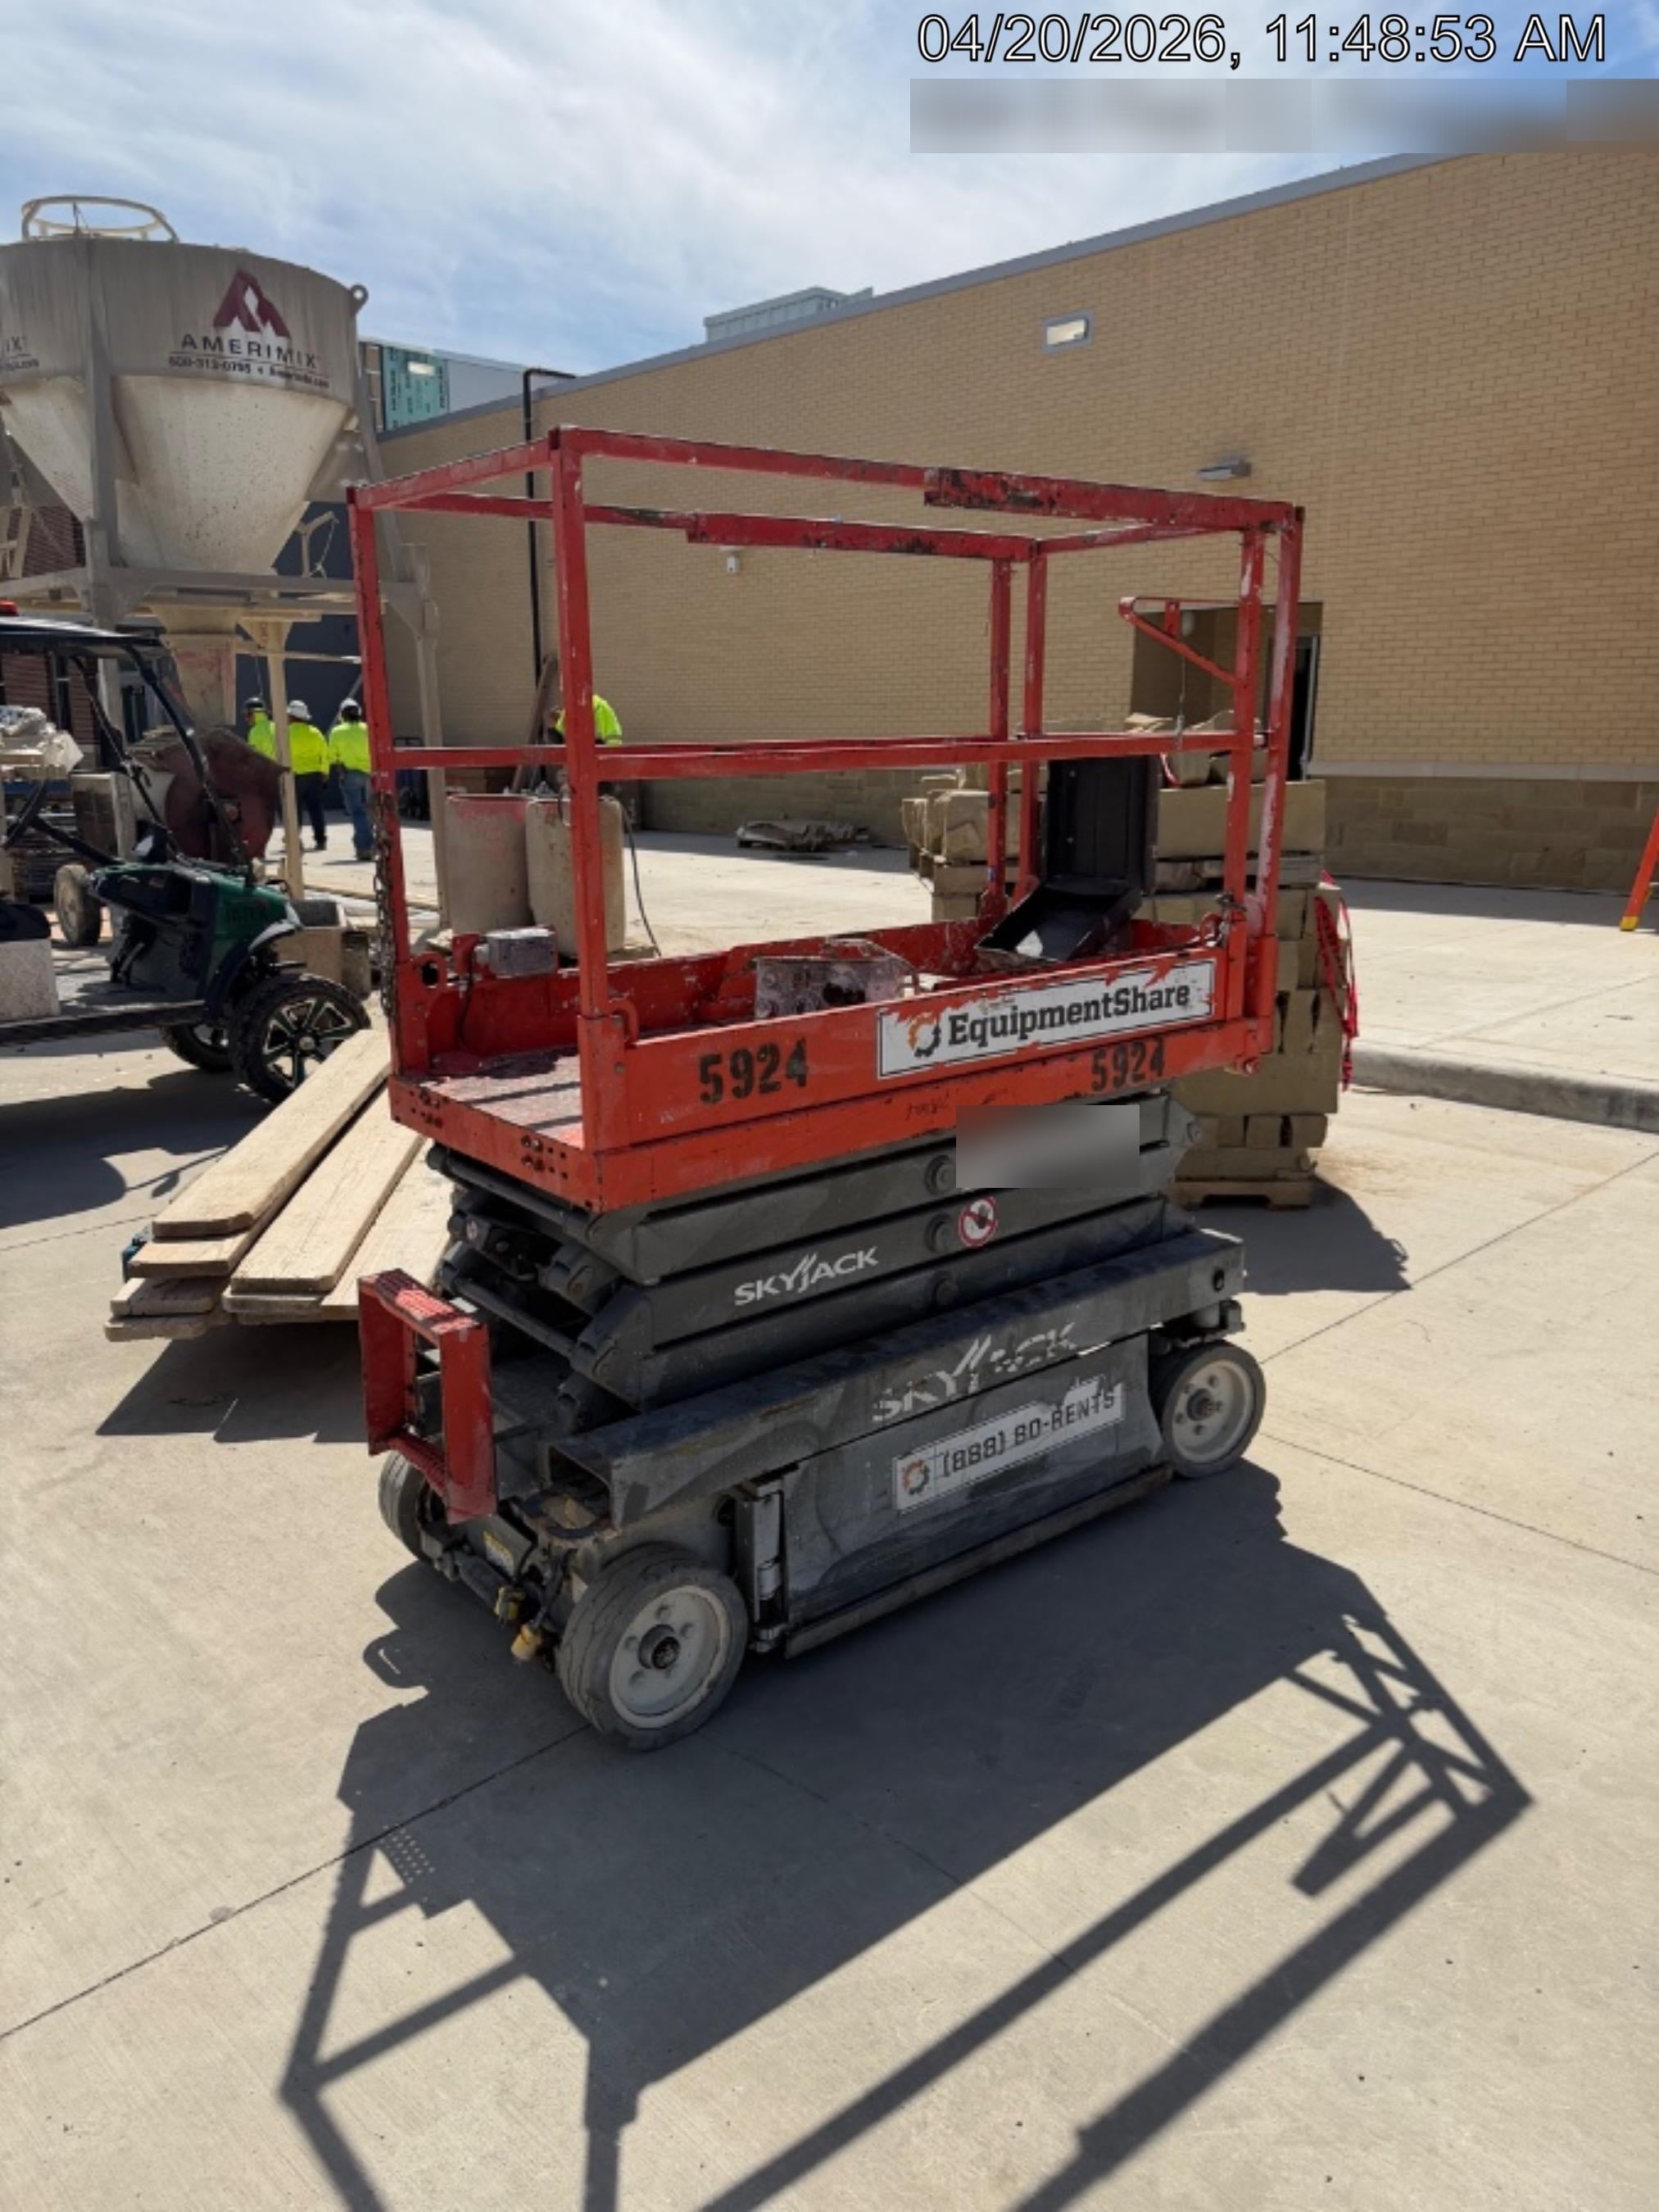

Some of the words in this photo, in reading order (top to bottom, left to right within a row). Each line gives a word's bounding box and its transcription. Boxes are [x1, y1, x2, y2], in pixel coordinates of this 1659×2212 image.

[181, 333, 318, 368] AMERIMIX
[948, 984, 1190, 1048] EquipmentShare
[699, 1036, 807, 1104] 5924
[1091, 1036, 1164, 1091] 5924
[734, 1245, 879, 1306] SKYJACK
